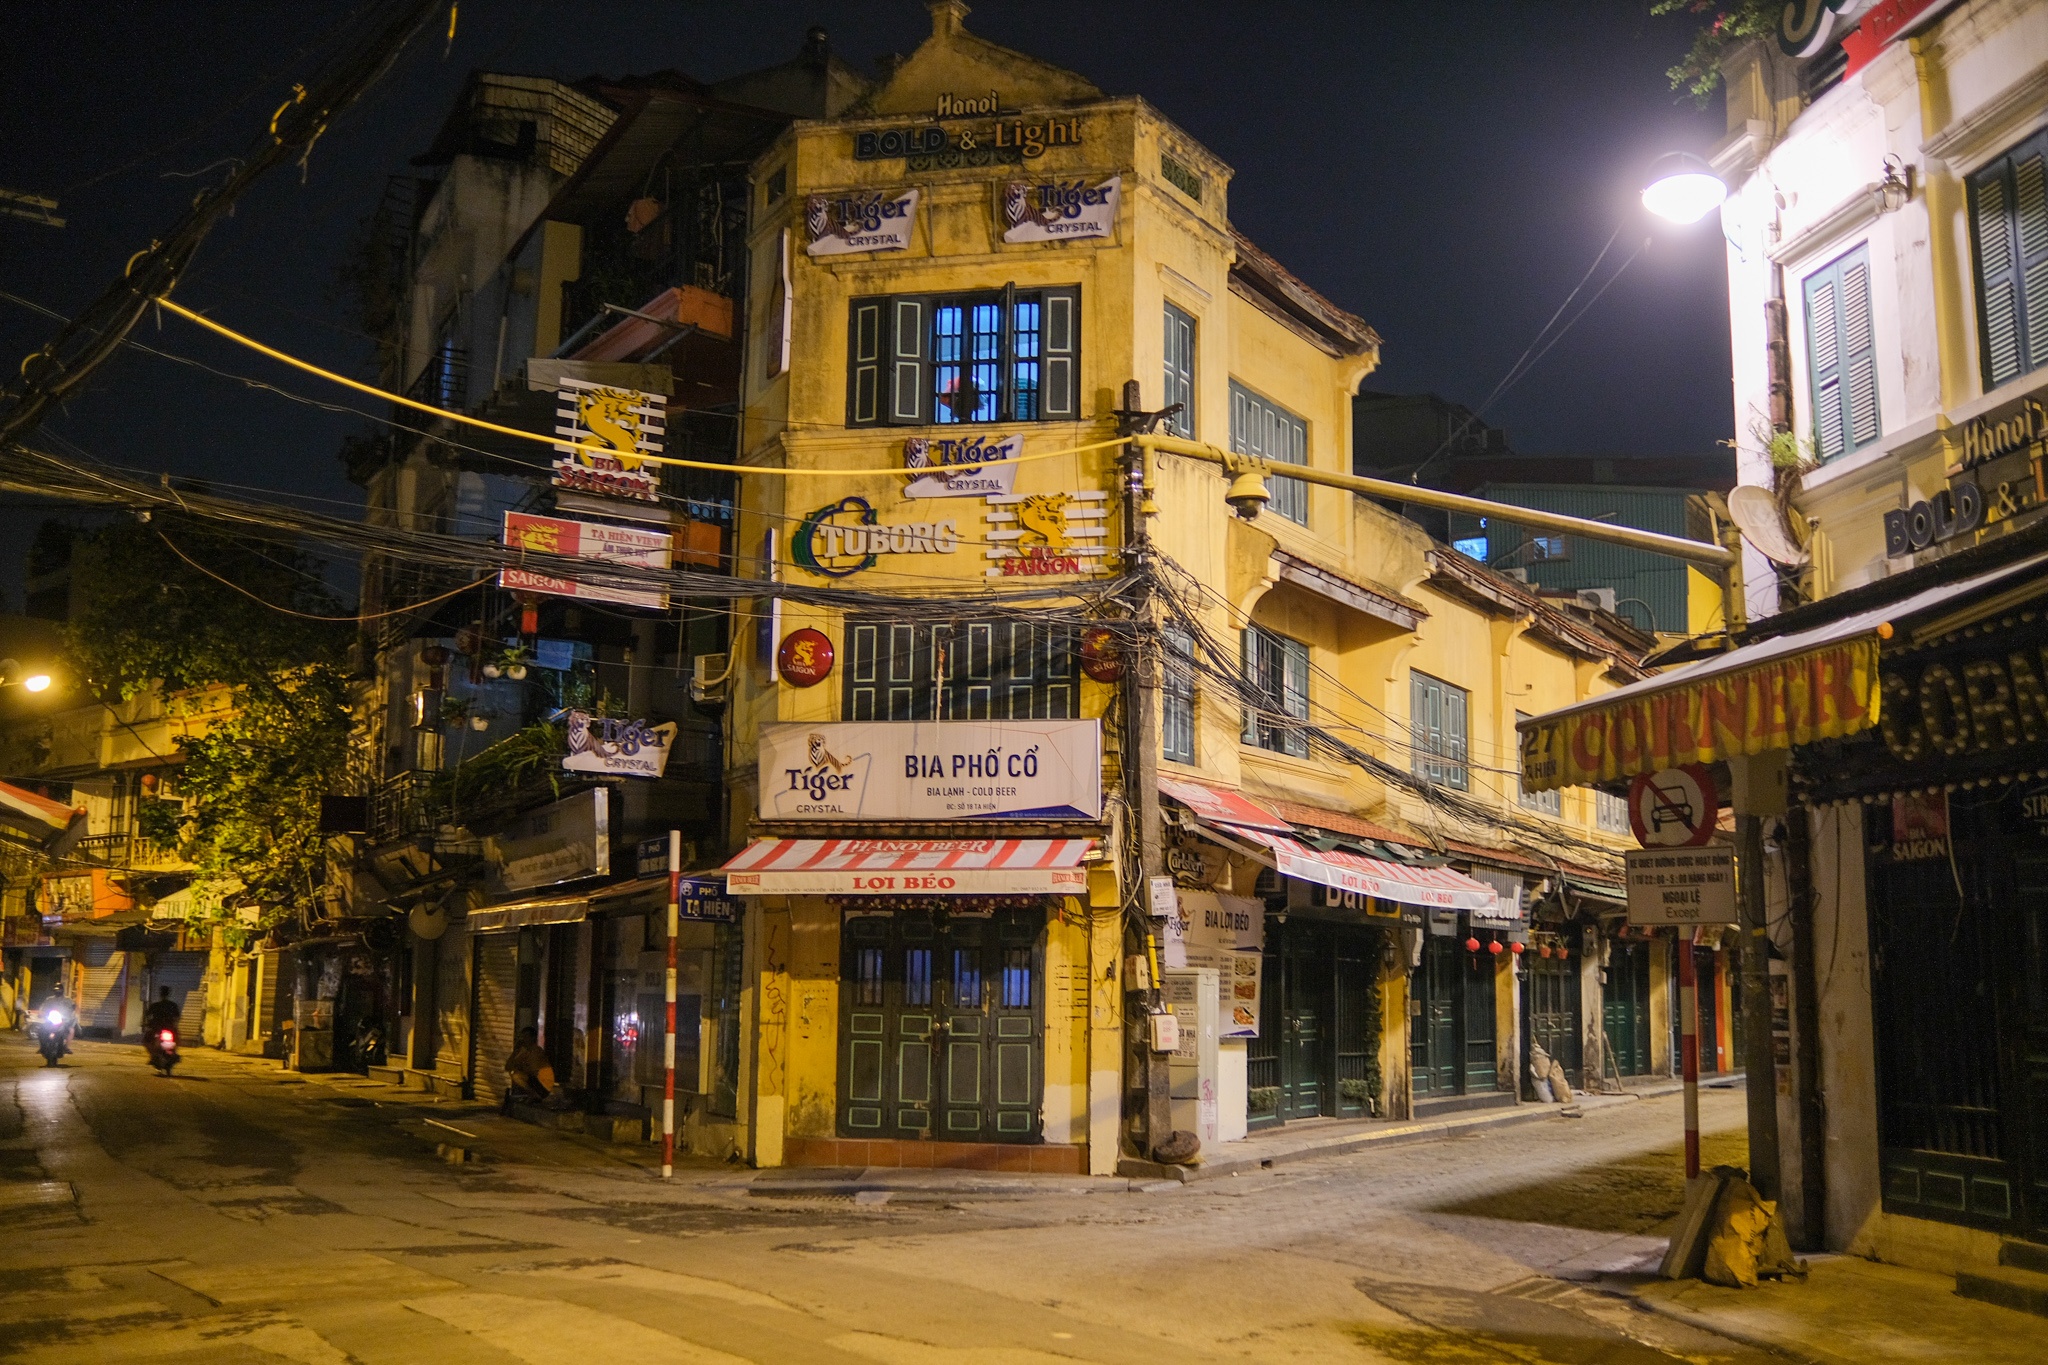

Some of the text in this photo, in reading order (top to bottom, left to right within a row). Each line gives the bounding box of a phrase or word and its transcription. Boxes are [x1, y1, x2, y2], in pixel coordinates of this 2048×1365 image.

[937, 90, 998, 117] Hanoi
[857, 120, 1081, 161] BOLD & Light
[1038, 179, 1112, 219] Tiger
[835, 192, 911, 231] Tiger
[1047, 221, 1102, 234] CRYSTAL
[848, 235, 902, 247] CRYSTAL
[939, 435, 1014, 476] Tiger
[947, 479, 1003, 490] CRYSTAL
[1884, 481, 1985, 560] BOLD
[635, 535, 664, 548] VIEW
[818, 519, 958, 558] TUBORG
[1004, 556, 1080, 577] SAIGON
[1572, 650, 1868, 772] CORNER
[598, 717, 671, 756] Tiger
[604, 756, 658, 772] CRYSTAL
[905, 745, 1039, 778] BIA PHỐ CỔ
[785, 766, 854, 801] Tiger
[927, 786, 942, 797] BIA
[944, 786, 965, 799] LẠNH
[972, 786, 993, 797] COLD
[996, 786, 1018, 797] BEER
[796, 804, 844, 814] CRYSTAL
[847, 840, 989, 855] HANOI BEER
[904, 873, 955, 889] BÉO
[1205, 909, 1220, 929] BIA
[1234, 909, 1250, 931] BÉO
[1666, 906, 1701, 920] Except
